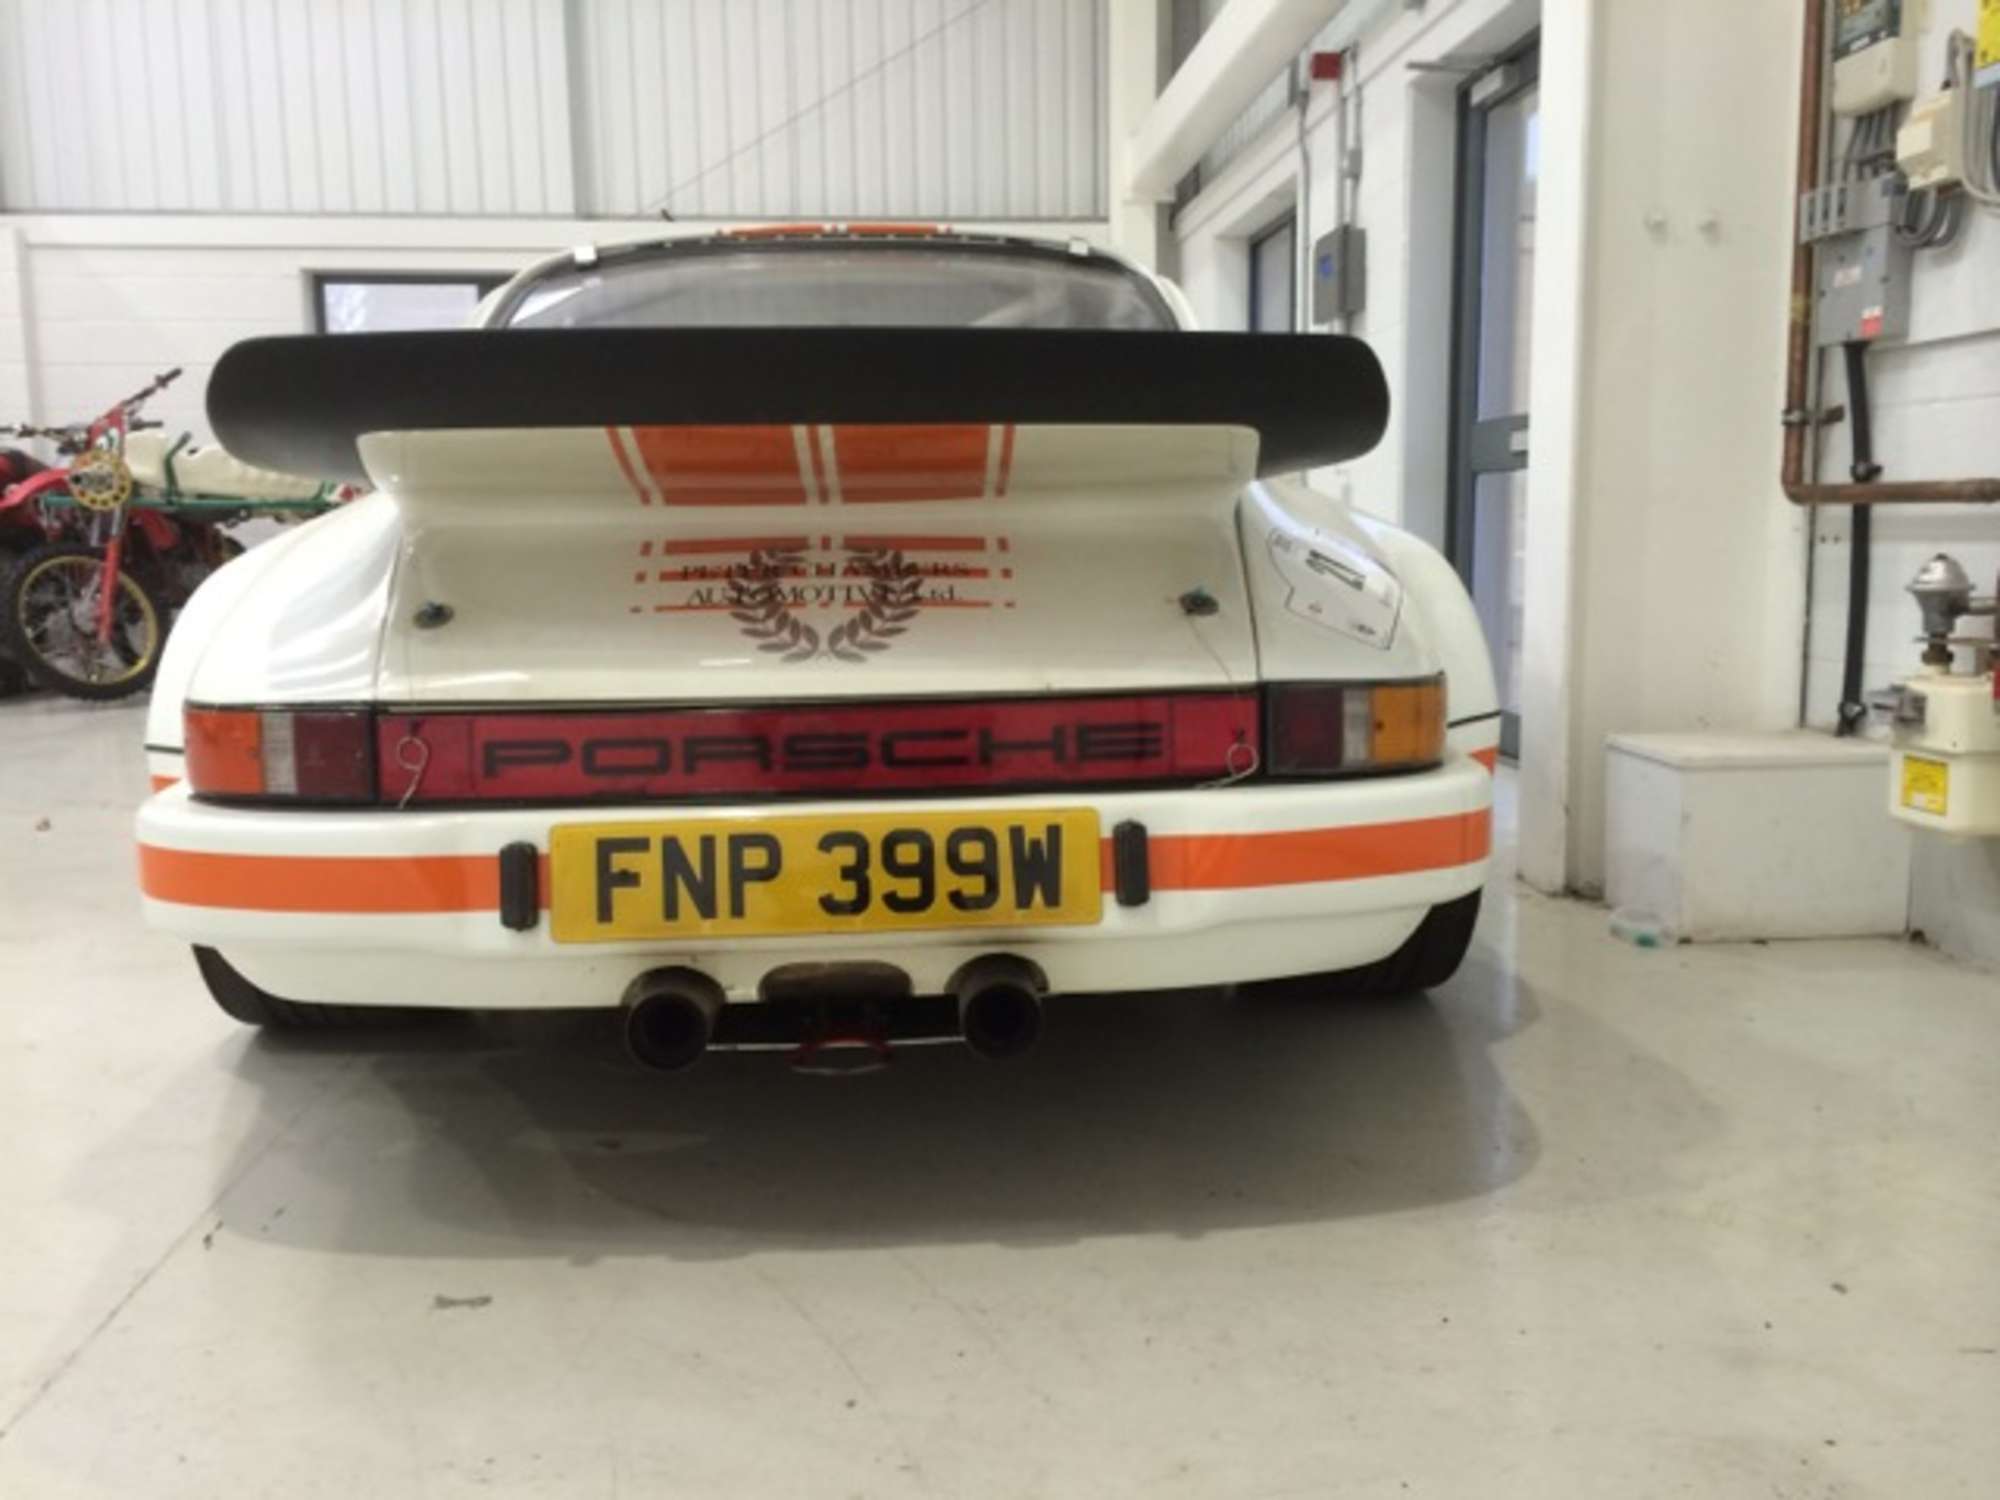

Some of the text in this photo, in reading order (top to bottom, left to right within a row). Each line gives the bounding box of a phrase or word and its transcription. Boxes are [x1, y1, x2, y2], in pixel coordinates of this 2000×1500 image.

[483, 721, 1163, 779] PORSCHE
[595, 824, 1063, 924] FNP 399W
